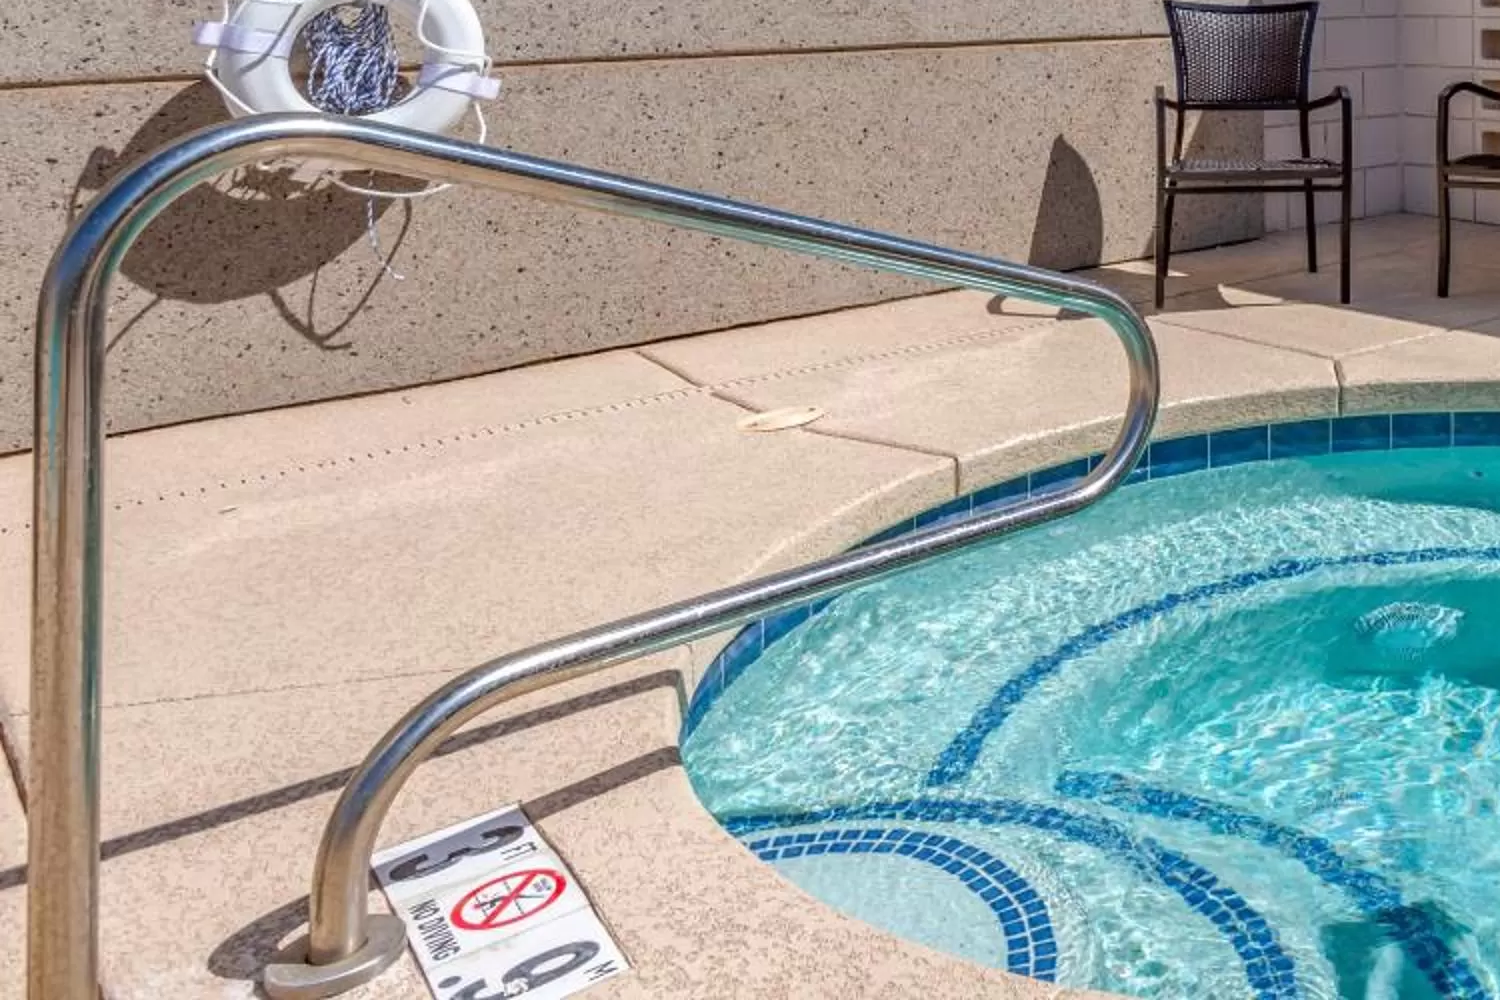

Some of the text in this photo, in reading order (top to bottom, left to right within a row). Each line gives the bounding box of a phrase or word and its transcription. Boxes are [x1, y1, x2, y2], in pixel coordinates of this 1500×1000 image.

[389, 825, 525, 882] 3
[408, 898, 462, 961] NO DIVING
